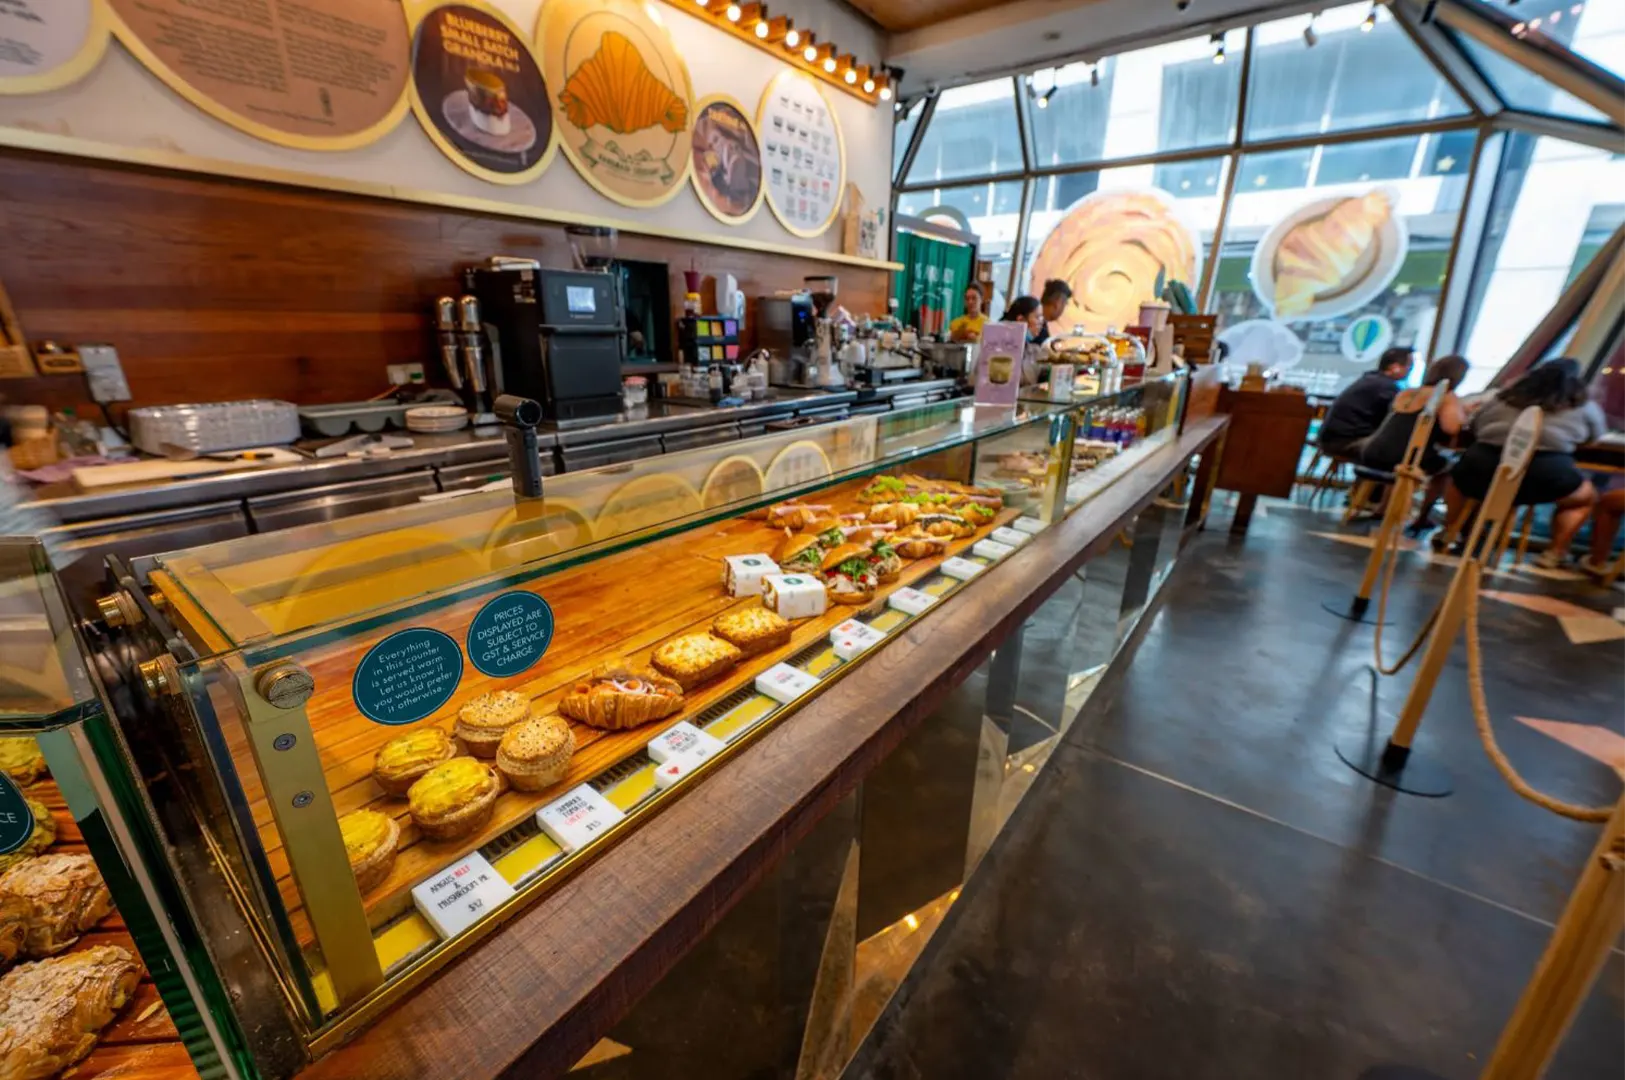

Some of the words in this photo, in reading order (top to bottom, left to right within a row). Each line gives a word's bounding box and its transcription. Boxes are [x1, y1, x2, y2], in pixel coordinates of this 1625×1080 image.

[477, 616, 523, 640] DISPLAYED
[526, 608, 542, 622] ARE
[494, 605, 523, 622] PRICES
[482, 647, 500, 661] GST
[503, 644, 510, 653] &
[511, 629, 545, 649] SERVICE
[487, 627, 523, 648] SUBJECT
[525, 622, 537, 633] TO
[373, 668, 383, 676] in
[386, 660, 404, 671] this
[406, 646, 440, 664] counter
[379, 640, 431, 663] Everything
[496, 645, 536, 667] CHARGE.
[371, 679, 380, 688] is
[383, 664, 415, 684] served
[417, 656, 447, 670] warm.
[380, 684, 394, 696] Let
[396, 680, 408, 689] us
[409, 670, 435, 683] know
[437, 663, 444, 672] if
[374, 697, 392, 711] you
[395, 681, 424, 699] would
[426, 671, 453, 688] prefer
[387, 705, 395, 714] it
[397, 686, 447, 710] otherwise.
[430, 874, 456, 894] ANGUS
[437, 880, 480, 910] MUSHROOM
